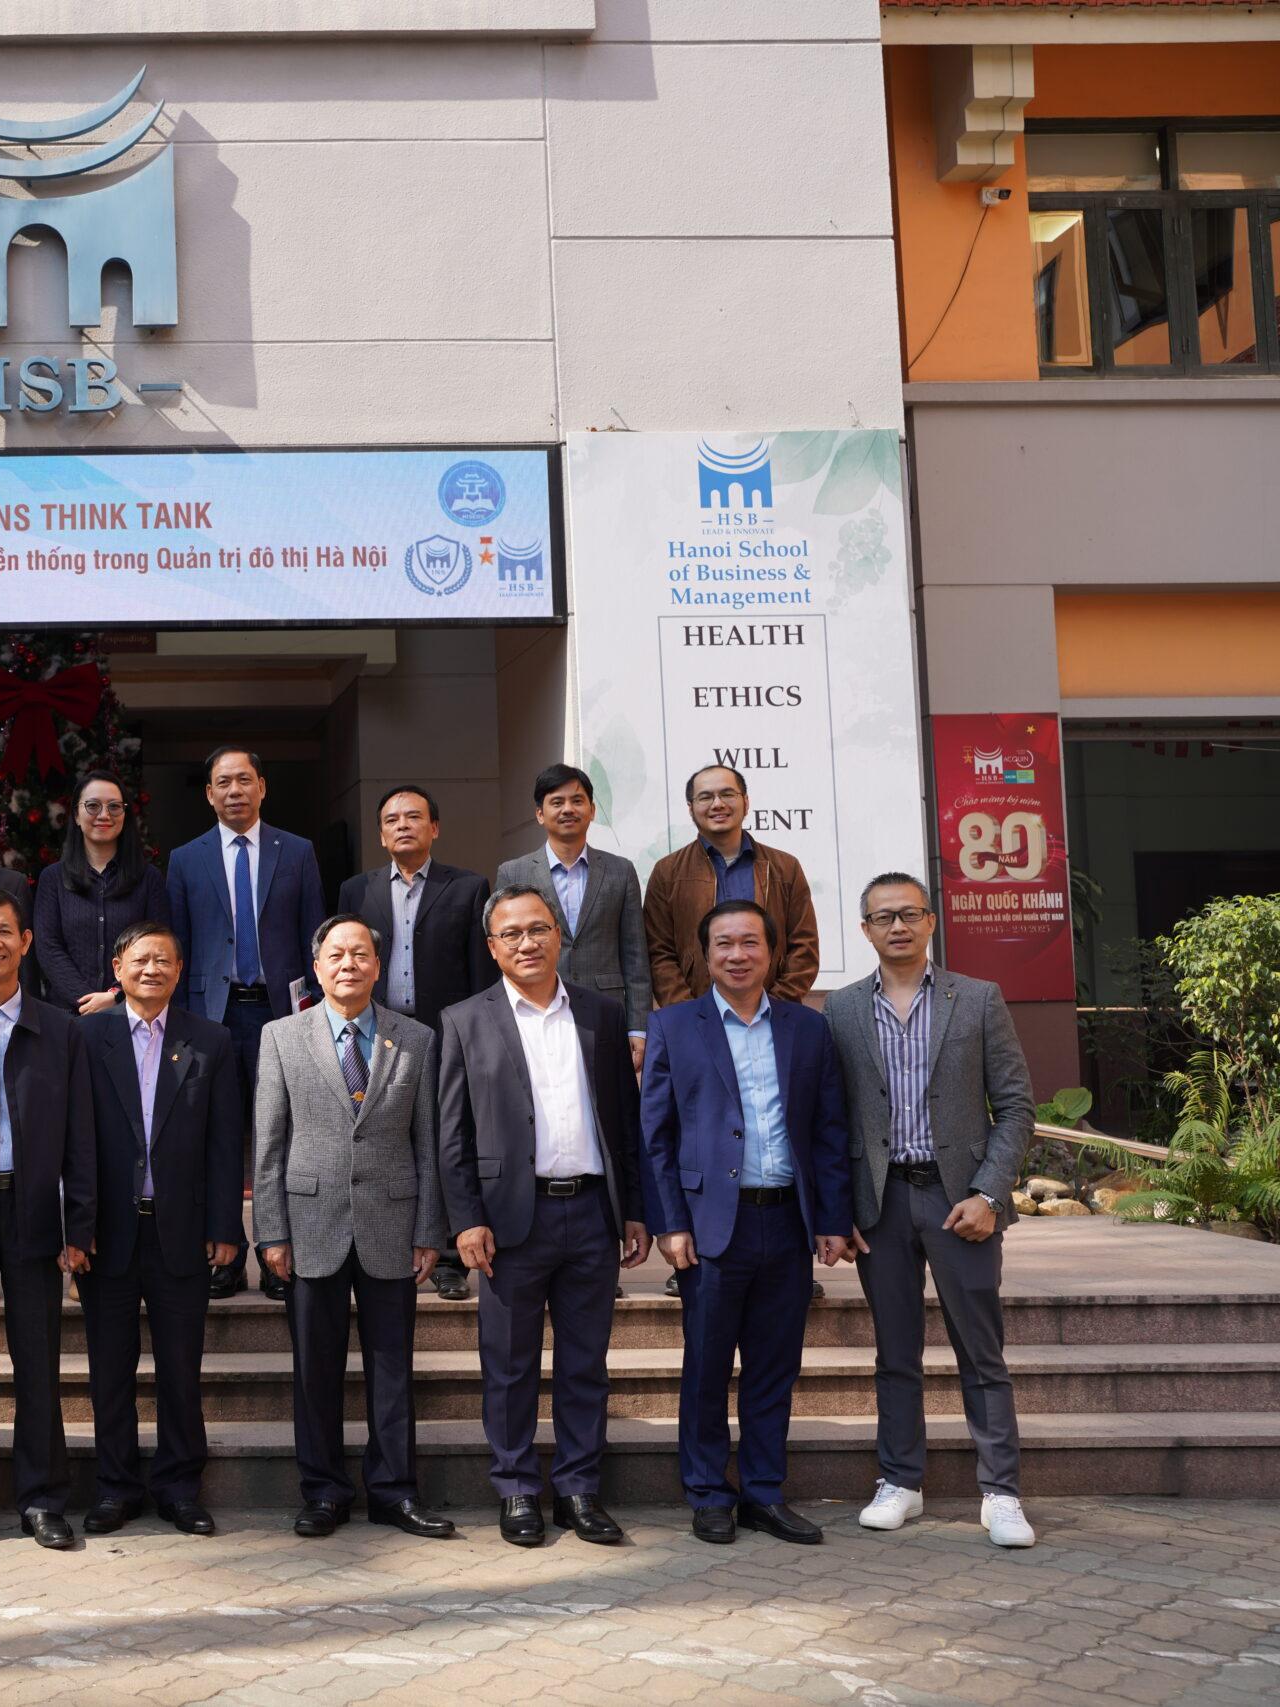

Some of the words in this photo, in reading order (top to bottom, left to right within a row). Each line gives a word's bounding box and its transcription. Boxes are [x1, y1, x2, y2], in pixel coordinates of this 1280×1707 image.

[40, 503, 127, 531] THINK
[136, 502, 213, 530] TANK
[717, 513, 758, 526] HSB
[668, 541, 731, 558] Hanoi
[739, 539, 809, 557] School
[27, 546, 85, 575] thống
[94, 550, 149, 574] trong
[157, 545, 211, 570] Quản
[219, 547, 241, 573] trị
[249, 547, 274, 568] đô
[282, 547, 308, 573] thị
[317, 546, 344, 568] Hà
[353, 546, 387, 572] Nội
[669, 564, 690, 582] of
[696, 564, 787, 581] Business
[793, 564, 811, 580] &
[509, 583, 534, 592] HSB
[671, 587, 811, 610] Management
[682, 624, 805, 647] HEALTH
[692, 685, 802, 708] ETHICS
[712, 747, 789, 769] WILL
[958, 811, 1047, 881] 80
[951, 891, 982, 911] NGÀY
[986, 889, 1019, 911] QUỐC
[1022, 889, 1064, 909] KHÁNH
